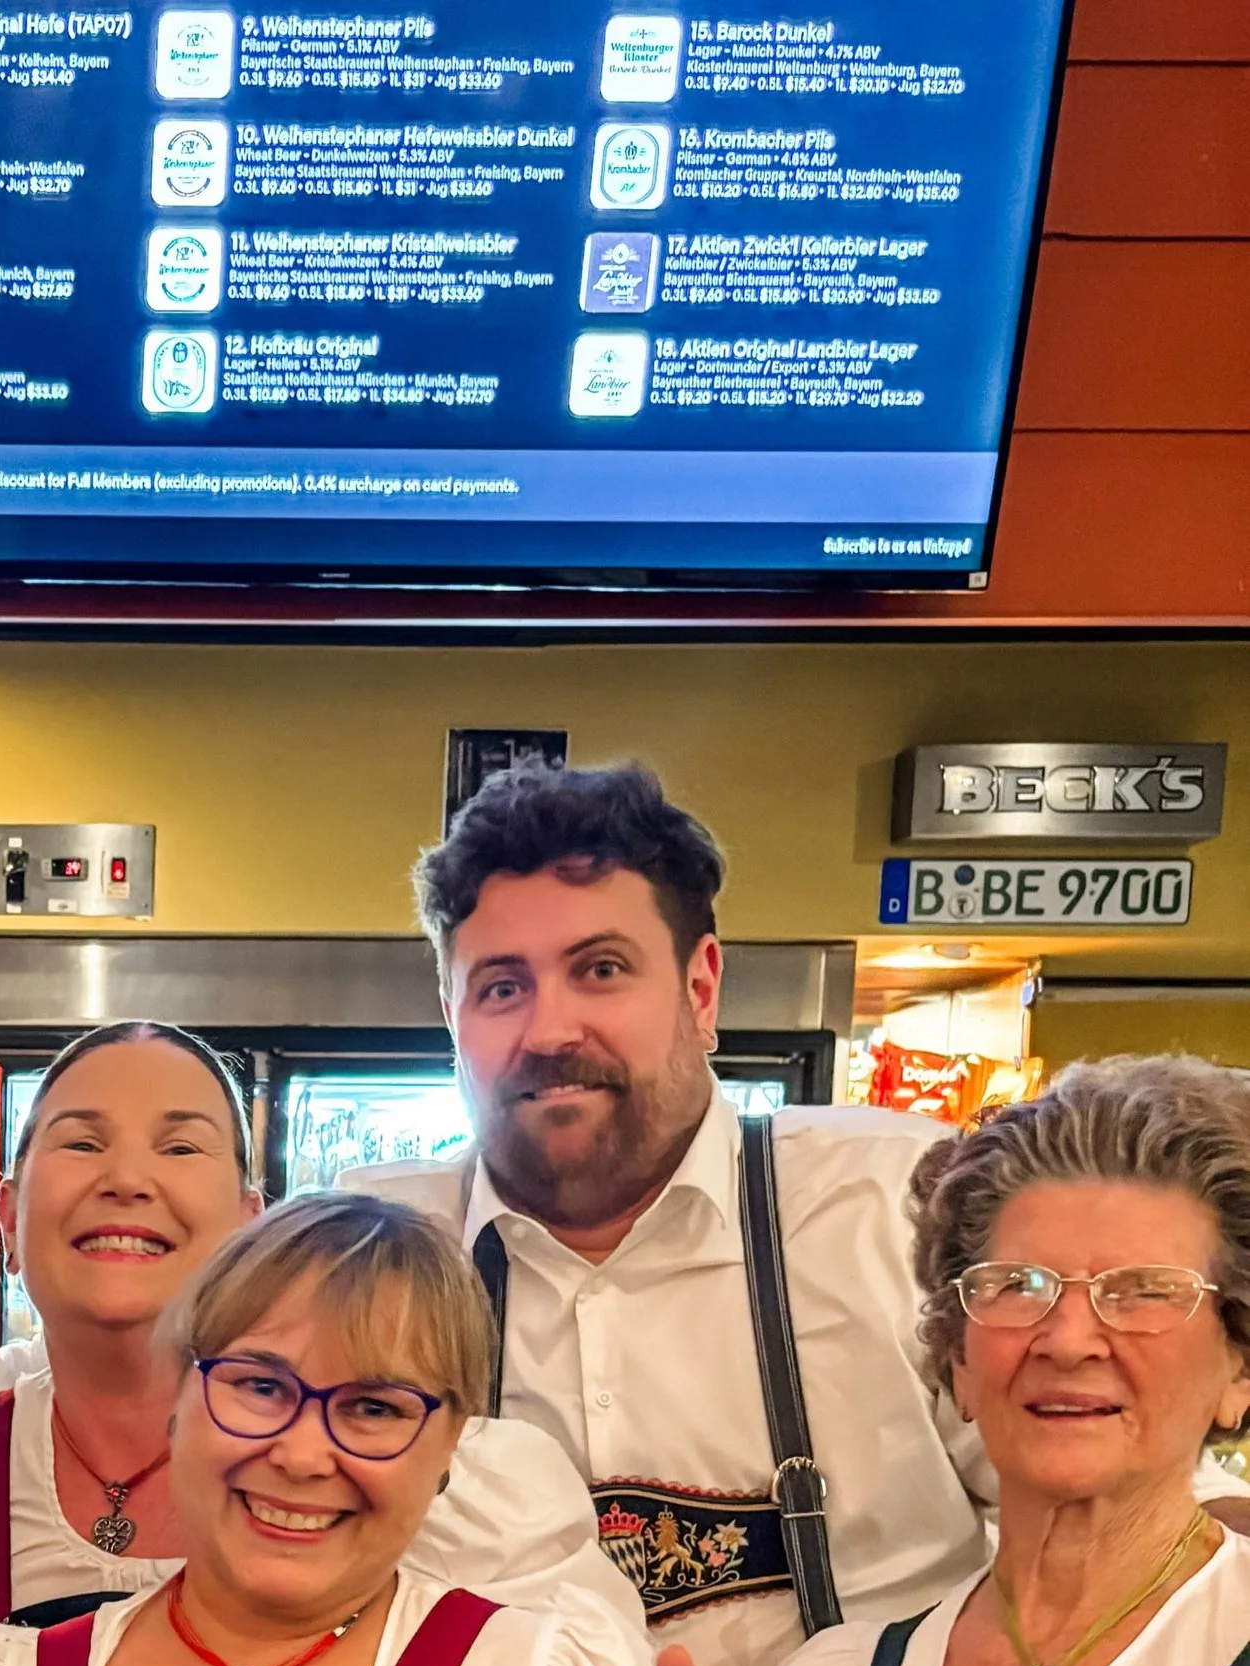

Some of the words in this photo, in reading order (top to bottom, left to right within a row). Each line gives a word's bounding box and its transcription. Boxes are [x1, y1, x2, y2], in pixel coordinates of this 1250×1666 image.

[27, 13, 65, 33] Hefe
[68, 14, 132, 37] (TAP07)
[242, 17, 259, 36] 9.
[262, 17, 402, 38] Weihenstephaner
[691, 21, 713, 41] 15.
[716, 21, 773, 41] Barock
[776, 22, 834, 42] Dunkel
[242, 38, 280, 52] Pilsner
[291, 39, 336, 53] German
[374, 40, 399, 53] ABV
[610, 42, 673, 54] Weltenburger
[688, 43, 722, 59] Lager
[732, 44, 774, 57] Munich
[776, 44, 816, 58] Dunkel
[826, 45, 853, 59] 4.7%
[855, 46, 880, 59] ABV
[623, 53, 659, 62] Kloster
[237, 125, 260, 145] 10.
[263, 125, 401, 146] Weihenstephaner
[404, 126, 515, 147] Hefeweissbier
[518, 127, 575, 146] Dunkel
[680, 128, 702, 148] 16.
[705, 129, 803, 149] Krombacher
[236, 148, 272, 161] Wheat
[275, 148, 301, 161] Beer
[312, 147, 389, 162] Dunkelweizen
[429, 149, 454, 162] ABV
[677, 151, 715, 165] Pilsner
[726, 152, 771, 165] German
[811, 153, 837, 166] ABV
[607, 163, 651, 175] Krombacher
[231, 232, 250, 251] 11.
[253, 232, 390, 253] Weihenstephaner
[392, 233, 518, 253] Kristallweissbier
[668, 235, 687, 254] 17.
[690, 236, 741, 255] Aktien
[800, 237, 877, 256] Kellerbier
[879, 238, 927, 259] Lager
[230, 254, 266, 267] Wheat
[268, 254, 295, 267] Beer
[305, 254, 379, 268] Kristallweizen
[419, 255, 444, 268] ABV
[665, 256, 719, 270] Kellerbier
[728, 257, 793, 270] Zwickelbier
[831, 258, 857, 271] ABV
[225, 336, 247, 354] 12.
[251, 336, 313, 355] Hofbräu
[316, 336, 379, 357] Original
[680, 339, 731, 359] Aktien
[733, 339, 795, 360] Original
[869, 341, 918, 362] Lager
[224, 357, 256, 372] Lager
[336, 357, 360, 370] ABV
[654, 360, 686, 375] Lager
[696, 360, 762, 373] Dortmunder
[772, 361, 809, 375] Export
[847, 361, 872, 374] ABV
[48, 474, 66, 487] for
[68, 474, 90, 488] Full
[93, 473, 151, 488] Members
[154, 474, 220, 492] (excluding
[305, 476, 336, 490] 0.4%
[339, 477, 401, 493] surcharge
[404, 481, 420, 491] on
[422, 479, 451, 491] card
[454, 480, 518, 495] payments.
[824, 537, 876, 553] Subscribe
[878, 537, 890, 553] to
[892, 540, 906, 553] us
[907, 540, 921, 553] on
[924, 537, 972, 557] Untappd
[939, 757, 1204, 813] BECK'S
[914, 869, 945, 916] B
[981, 869, 1046, 917] BE
[1058, 868, 1184, 917] 9700
[888, 898, 900, 914] D
